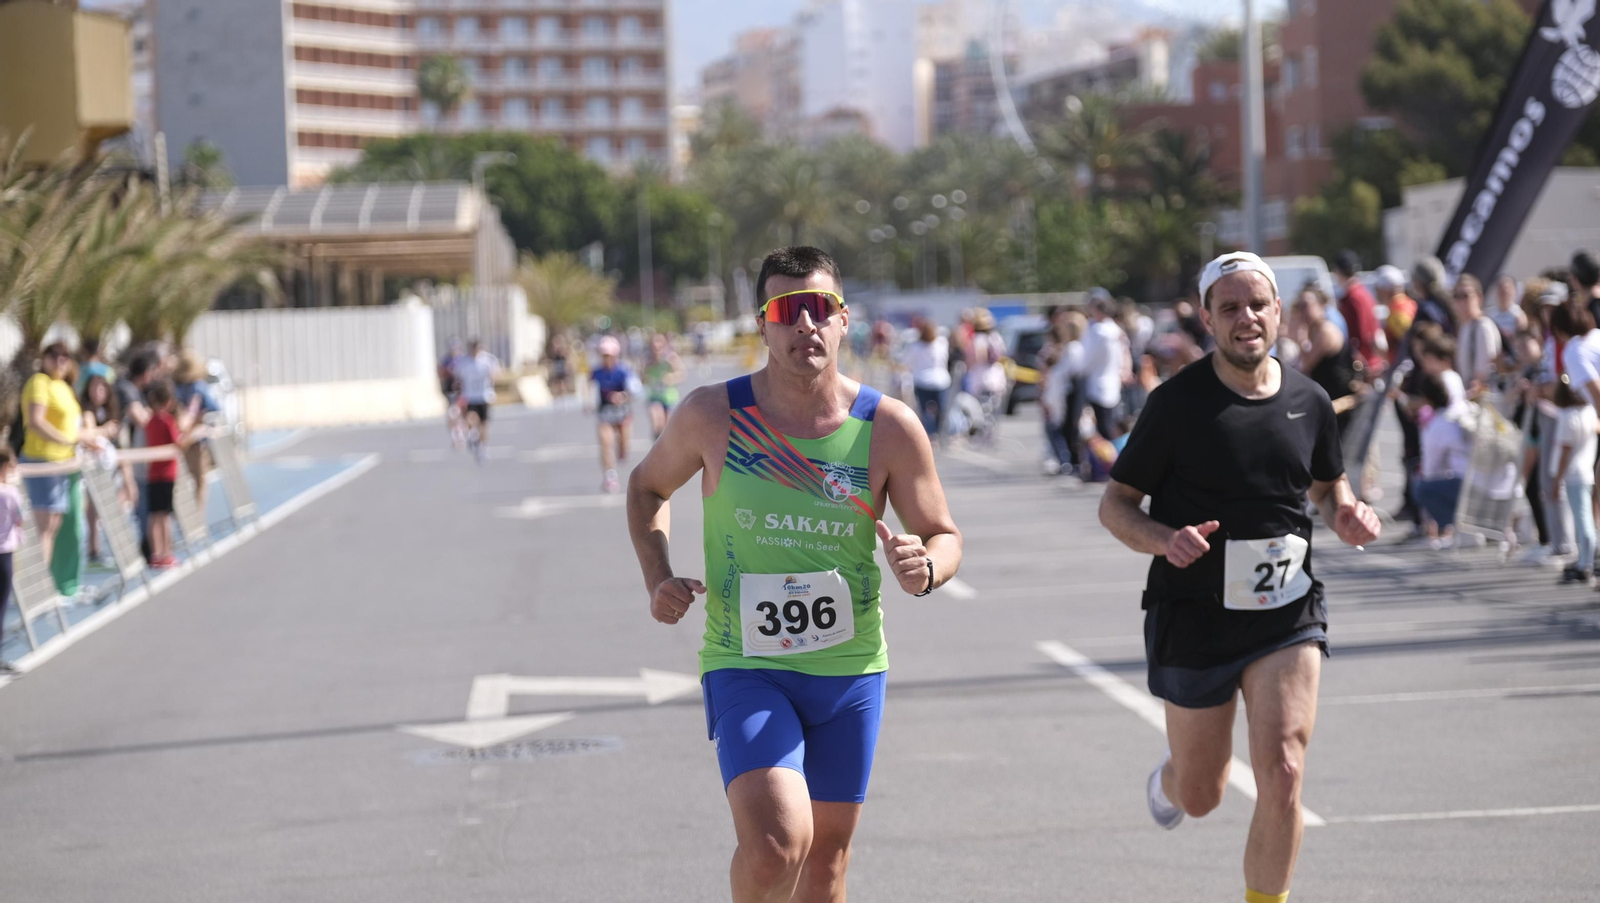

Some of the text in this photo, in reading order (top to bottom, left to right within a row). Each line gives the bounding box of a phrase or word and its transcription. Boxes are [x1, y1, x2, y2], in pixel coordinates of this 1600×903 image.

[764, 513, 855, 537] SAKATA
[755, 535, 840, 552] PASSION in Seed
[1254, 559, 1291, 593] 27
[755, 596, 837, 637] 396
